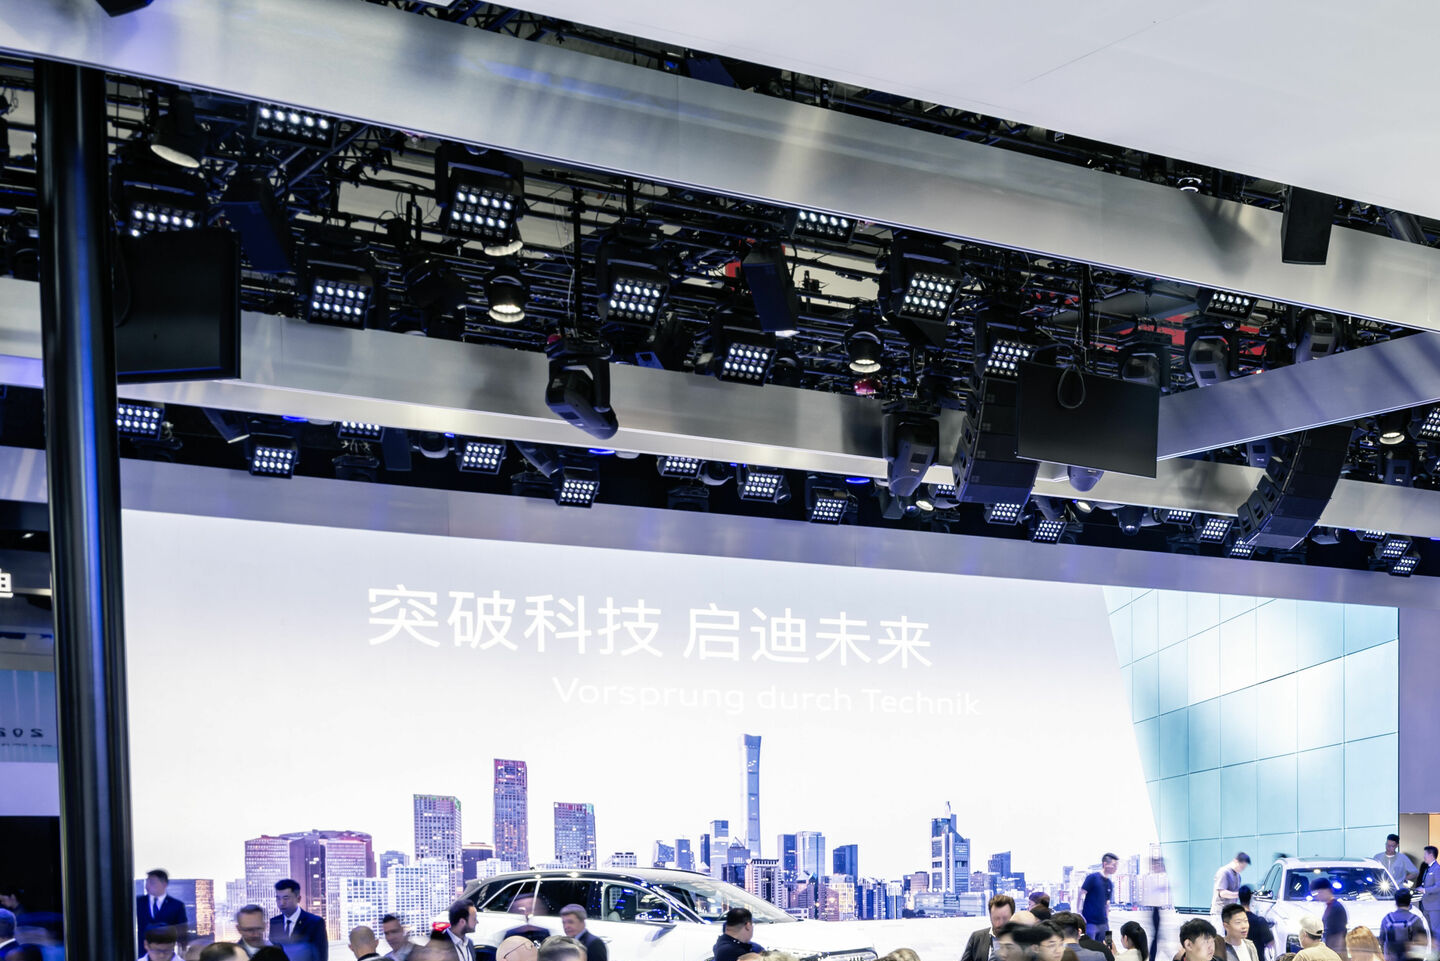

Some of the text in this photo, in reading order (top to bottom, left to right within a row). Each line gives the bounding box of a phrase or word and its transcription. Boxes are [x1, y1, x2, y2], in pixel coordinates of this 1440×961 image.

[367, 584, 933, 668] 突破科技 启迪未来
[552, 676, 982, 717] Vorsprung durch Technik
